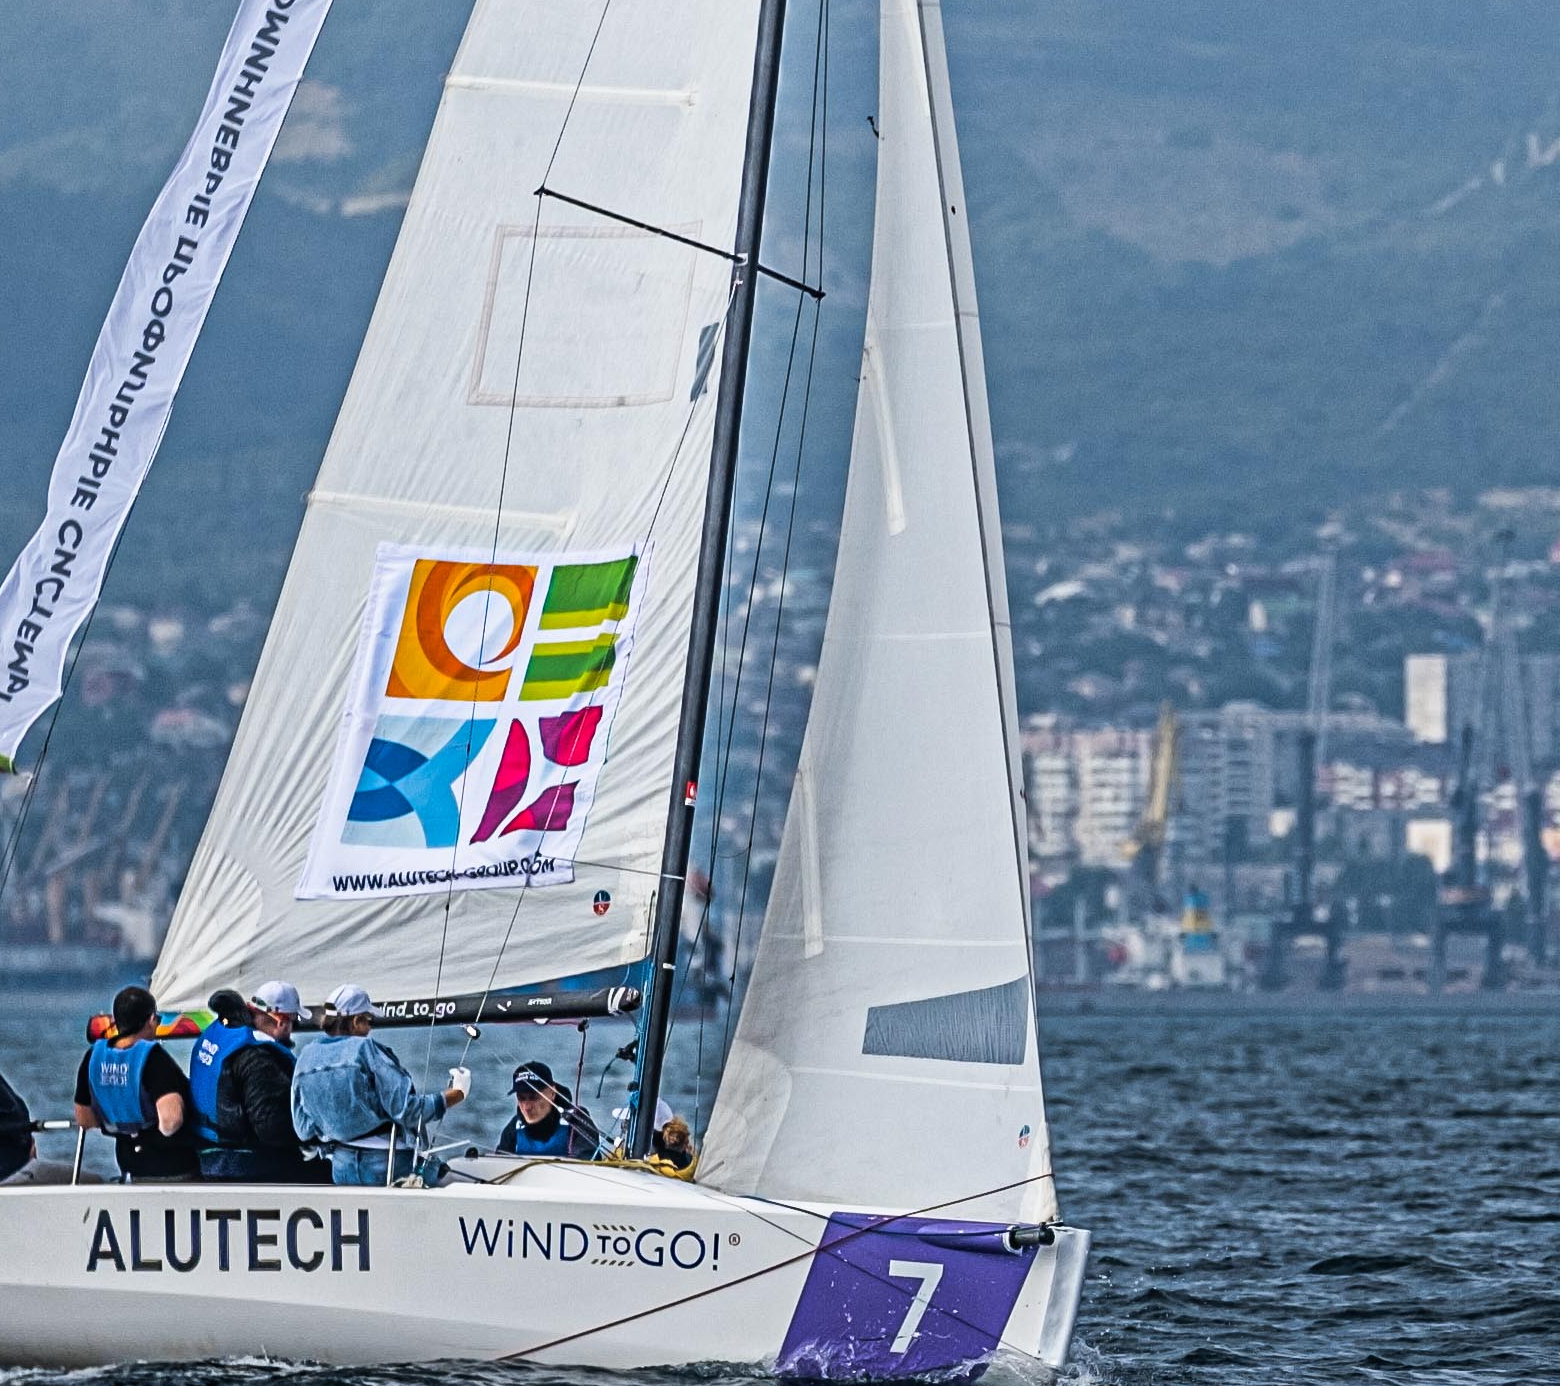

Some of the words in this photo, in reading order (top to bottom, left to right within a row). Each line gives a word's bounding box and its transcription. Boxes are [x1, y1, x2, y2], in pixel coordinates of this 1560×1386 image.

[380, 1001, 456, 1018] ind_to_go
[87, 1208, 370, 1272] ALUTECH
[889, 1260, 944, 1353] 7
